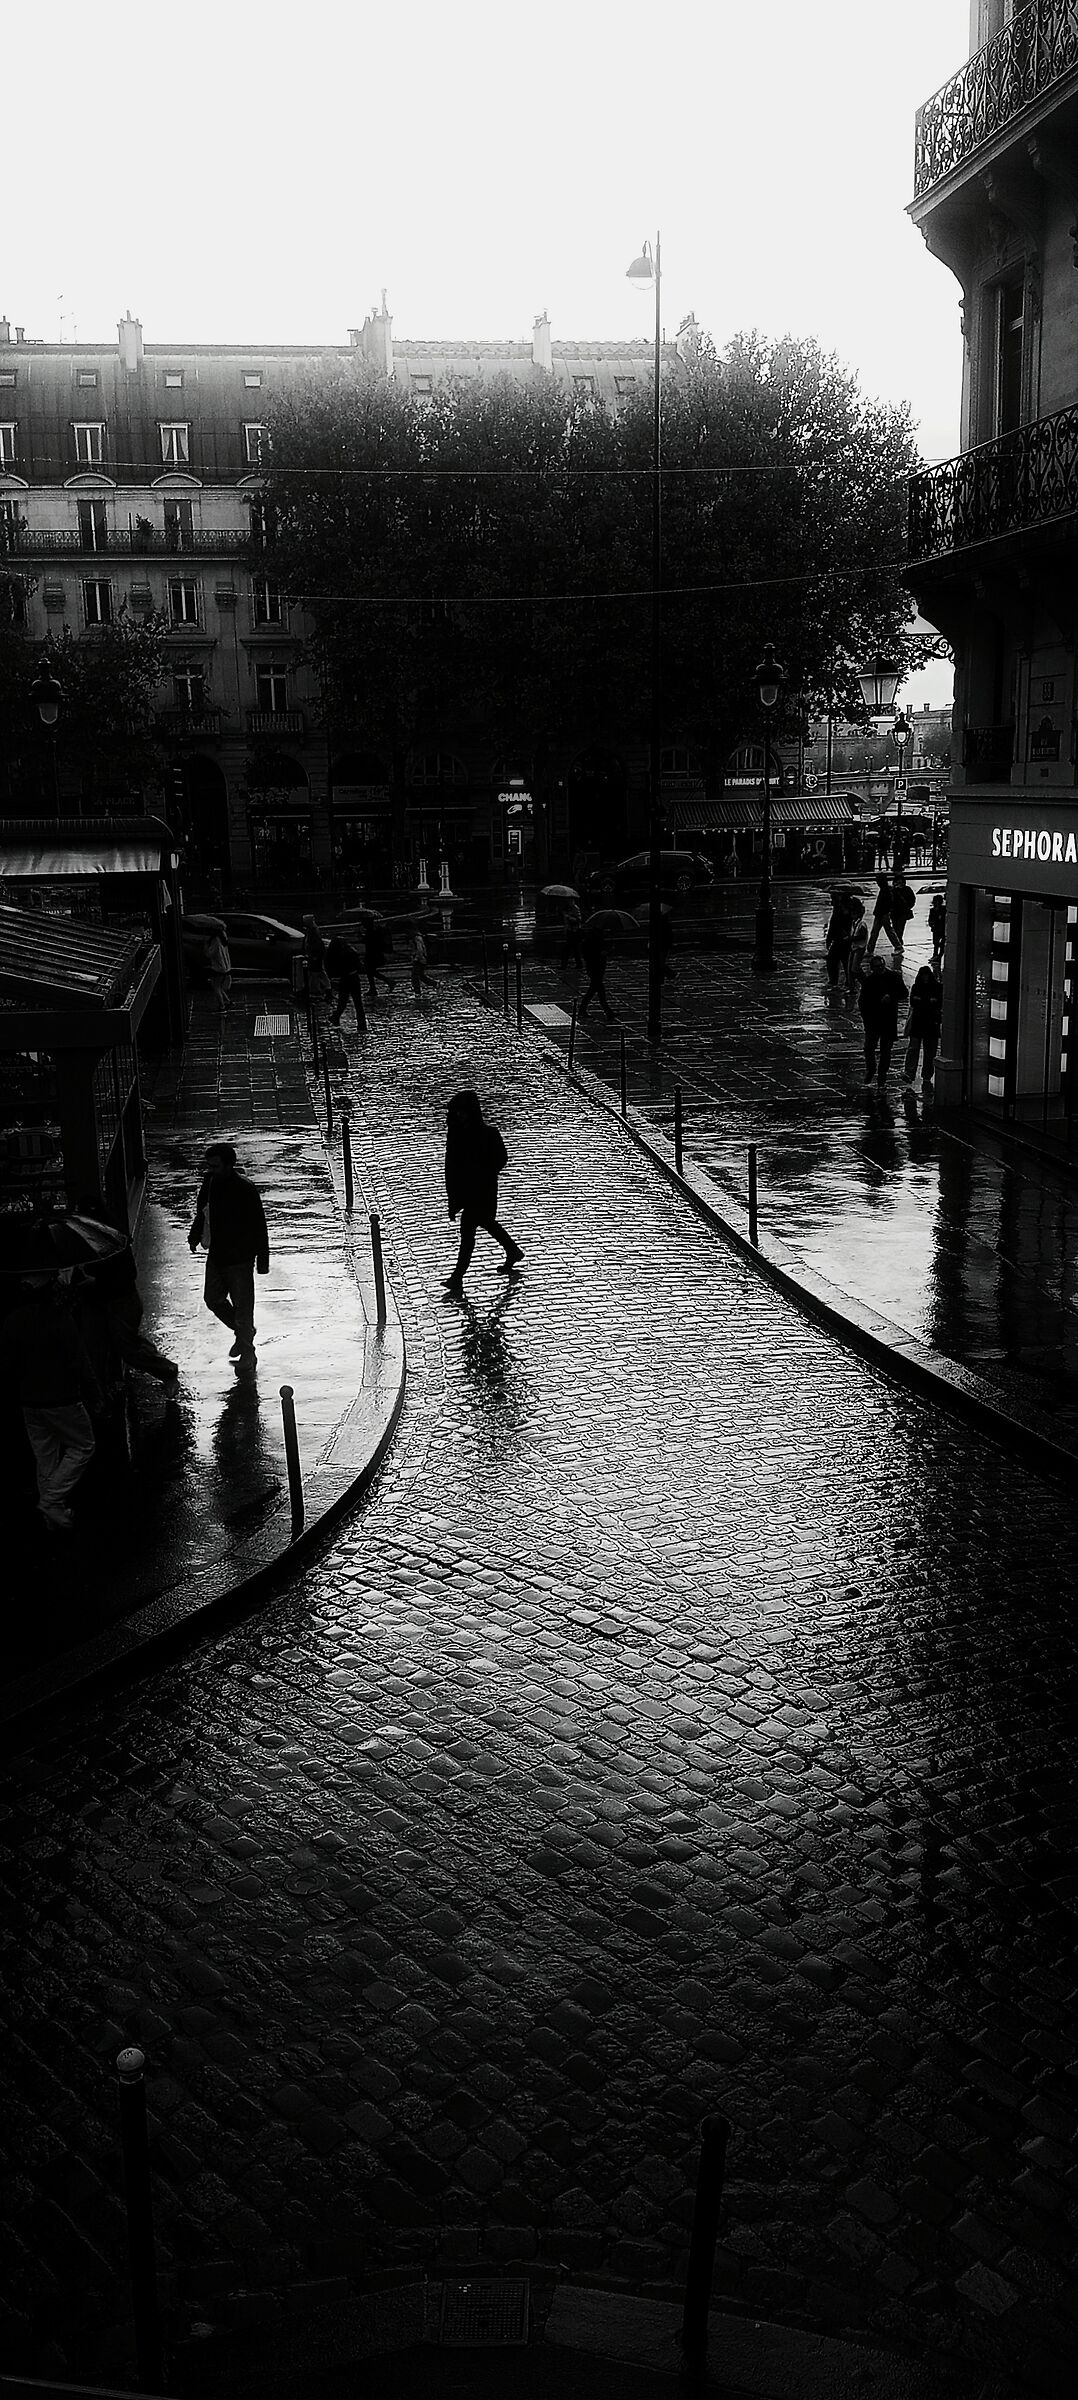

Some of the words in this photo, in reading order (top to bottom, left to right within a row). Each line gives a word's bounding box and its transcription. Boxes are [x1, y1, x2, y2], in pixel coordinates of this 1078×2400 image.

[724, 778, 732, 786] LE
[897, 780, 904, 789] P
[991, 827, 1077, 864] SEPHORA
